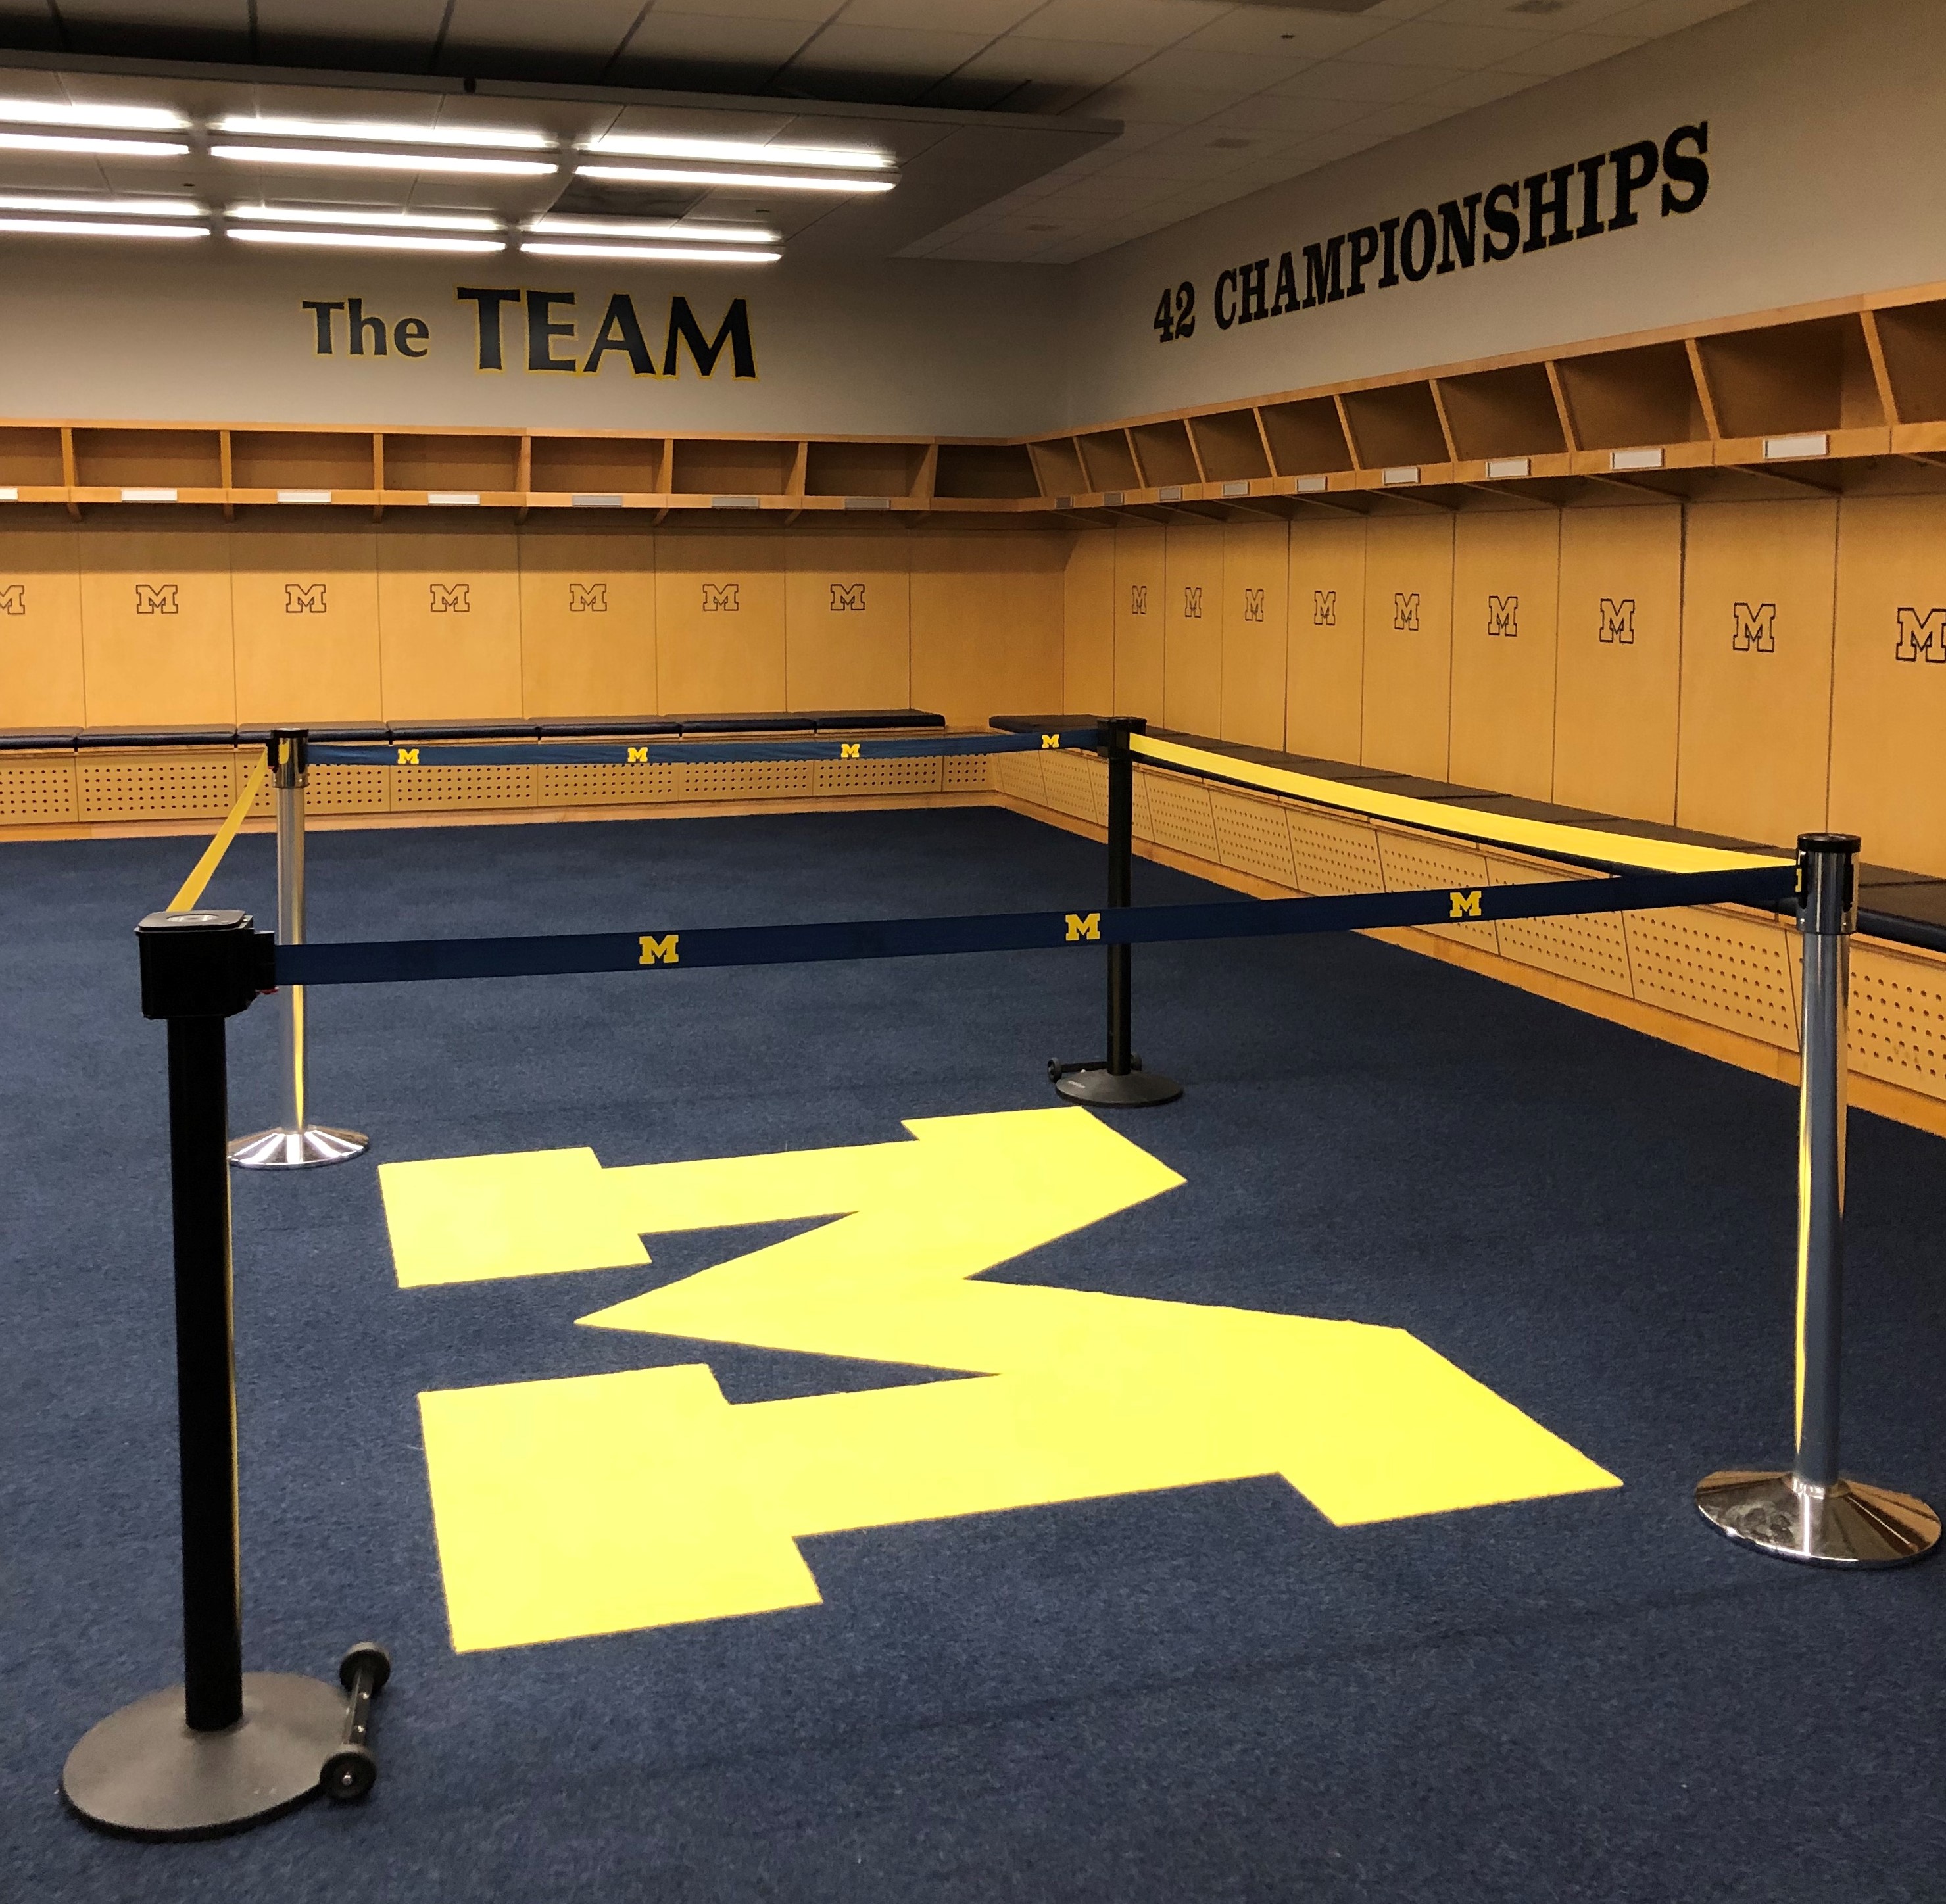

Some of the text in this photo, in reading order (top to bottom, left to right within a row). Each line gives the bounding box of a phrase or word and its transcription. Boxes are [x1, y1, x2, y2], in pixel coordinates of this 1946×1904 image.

[1153, 120, 1710, 343] 42 CHAMPIONSHIPS
[301, 286, 757, 379] The TEAM
[135, 584, 178, 614] M
[285, 584, 326, 613] M
[430, 584, 470, 612] M
[570, 584, 607, 612] M
[702, 584, 739, 612] M
[831, 584, 865, 611] M
[1131, 585, 1147, 614] M
[1184, 587, 1202, 618] M
[1245, 589, 1264, 622] M
[1314, 591, 1336, 626] M
[1394, 593, 1419, 631] M
[1488, 596, 1518, 637] M
[1599, 598, 1636, 645] M
[1732, 602, 1776, 653] M
[1895, 607, 1946, 664] M
[628, 747, 648, 762] M
[841, 743, 860, 758] M
[1042, 734, 1059, 748] M
[398, 748, 420, 764] M
[1450, 891, 1482, 918] M
[1066, 913, 1100, 941] M
[639, 935, 679, 964] M
[379, 1106, 1622, 1653] M
